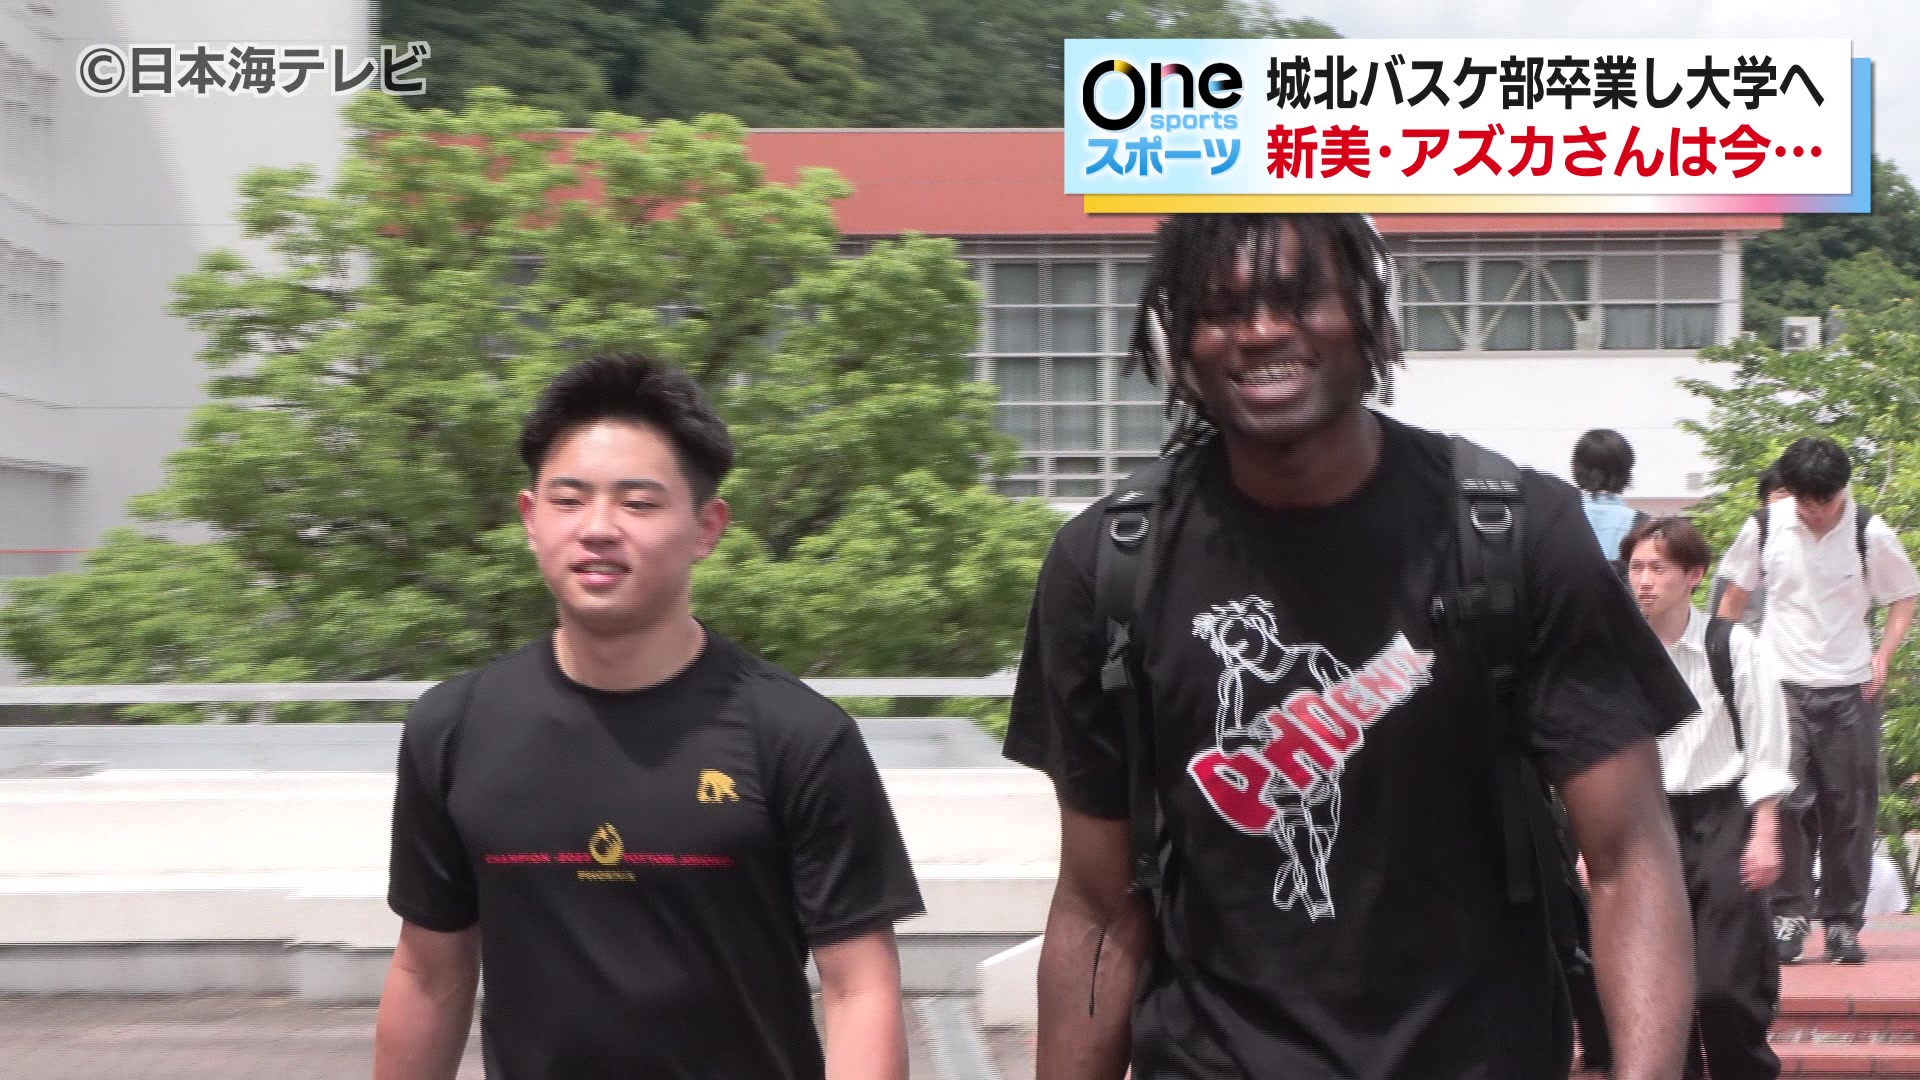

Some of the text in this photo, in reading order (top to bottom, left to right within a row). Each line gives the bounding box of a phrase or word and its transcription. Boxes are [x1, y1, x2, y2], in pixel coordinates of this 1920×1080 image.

[1187, 631, 1436, 836] PHOENIX
[485, 852, 552, 865] CHAMPION
[576, 871, 637, 882] PHOENIX
